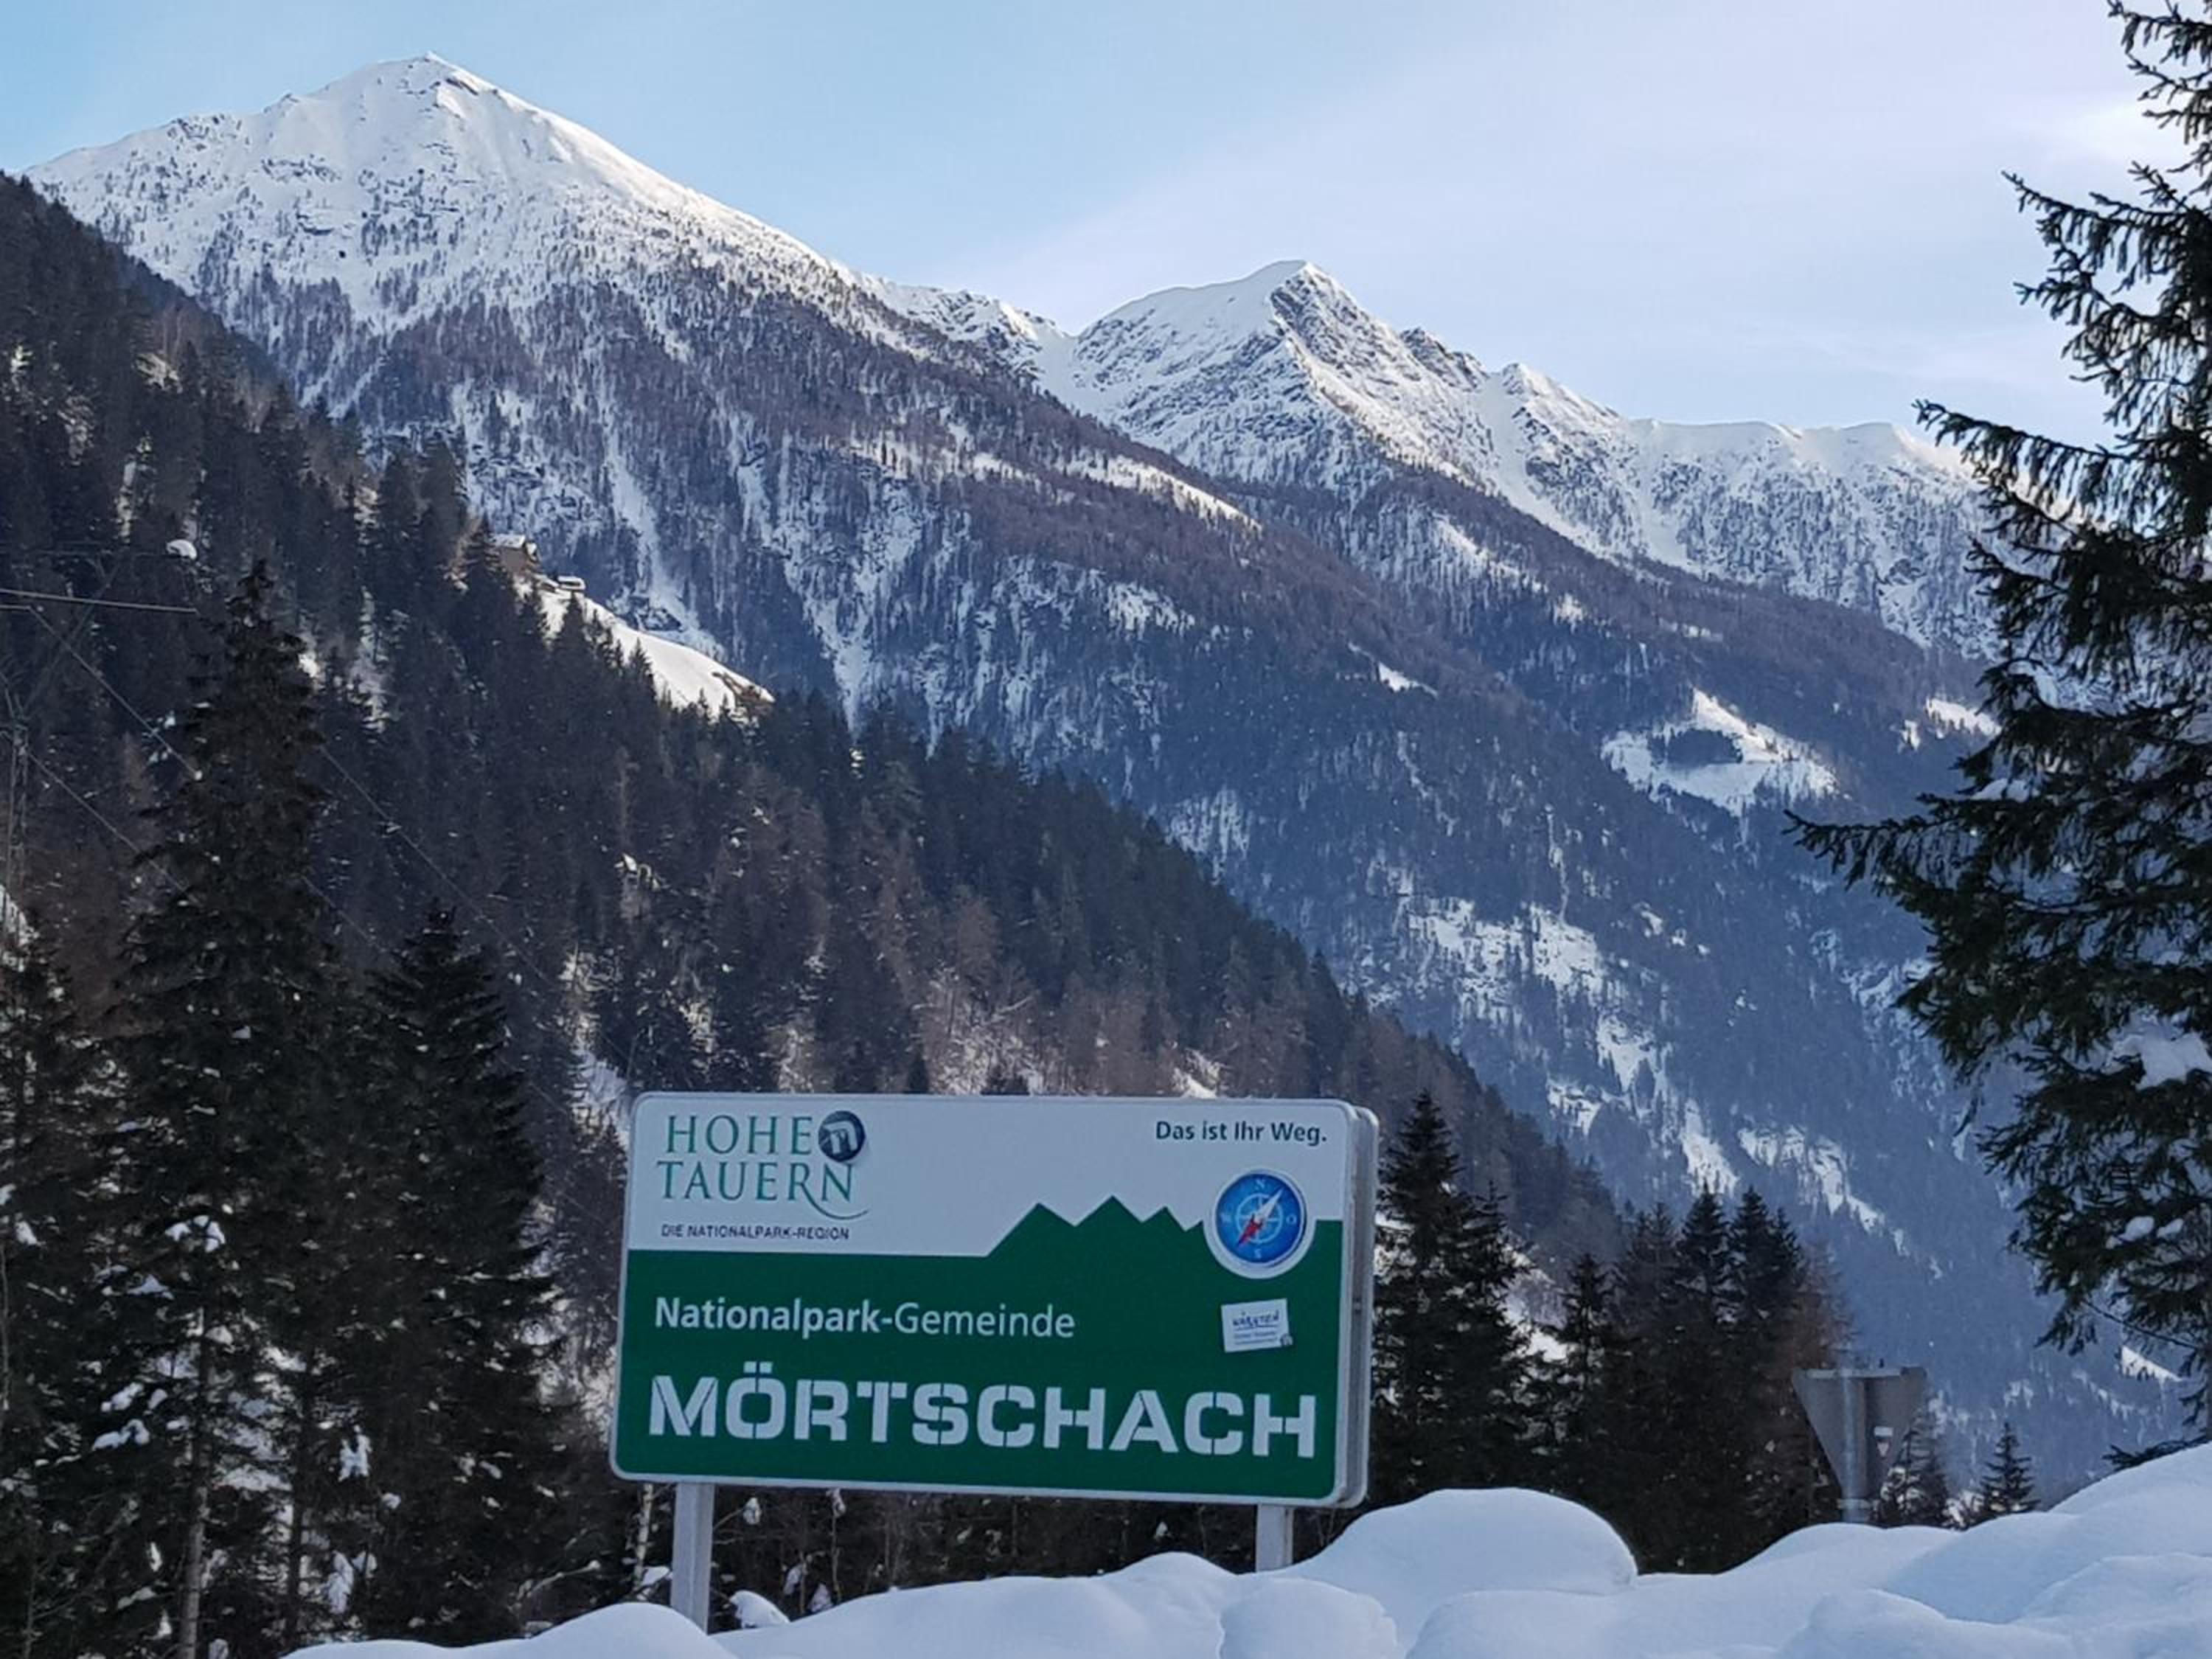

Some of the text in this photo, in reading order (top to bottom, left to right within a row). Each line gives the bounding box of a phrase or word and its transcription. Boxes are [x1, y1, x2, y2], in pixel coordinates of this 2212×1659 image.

[667, 1114, 812, 1156] HOHE
[1155, 1120, 1327, 1147] Das ist Ihr Weg.
[655, 1160, 869, 1220] TAUERN
[661, 1223, 850, 1240] DIE NATIONALPARK-REGION
[654, 1295, 1075, 1339] Nationalpark-Gemeinde
[648, 1361, 1318, 1459] MÖRTSCHACH
